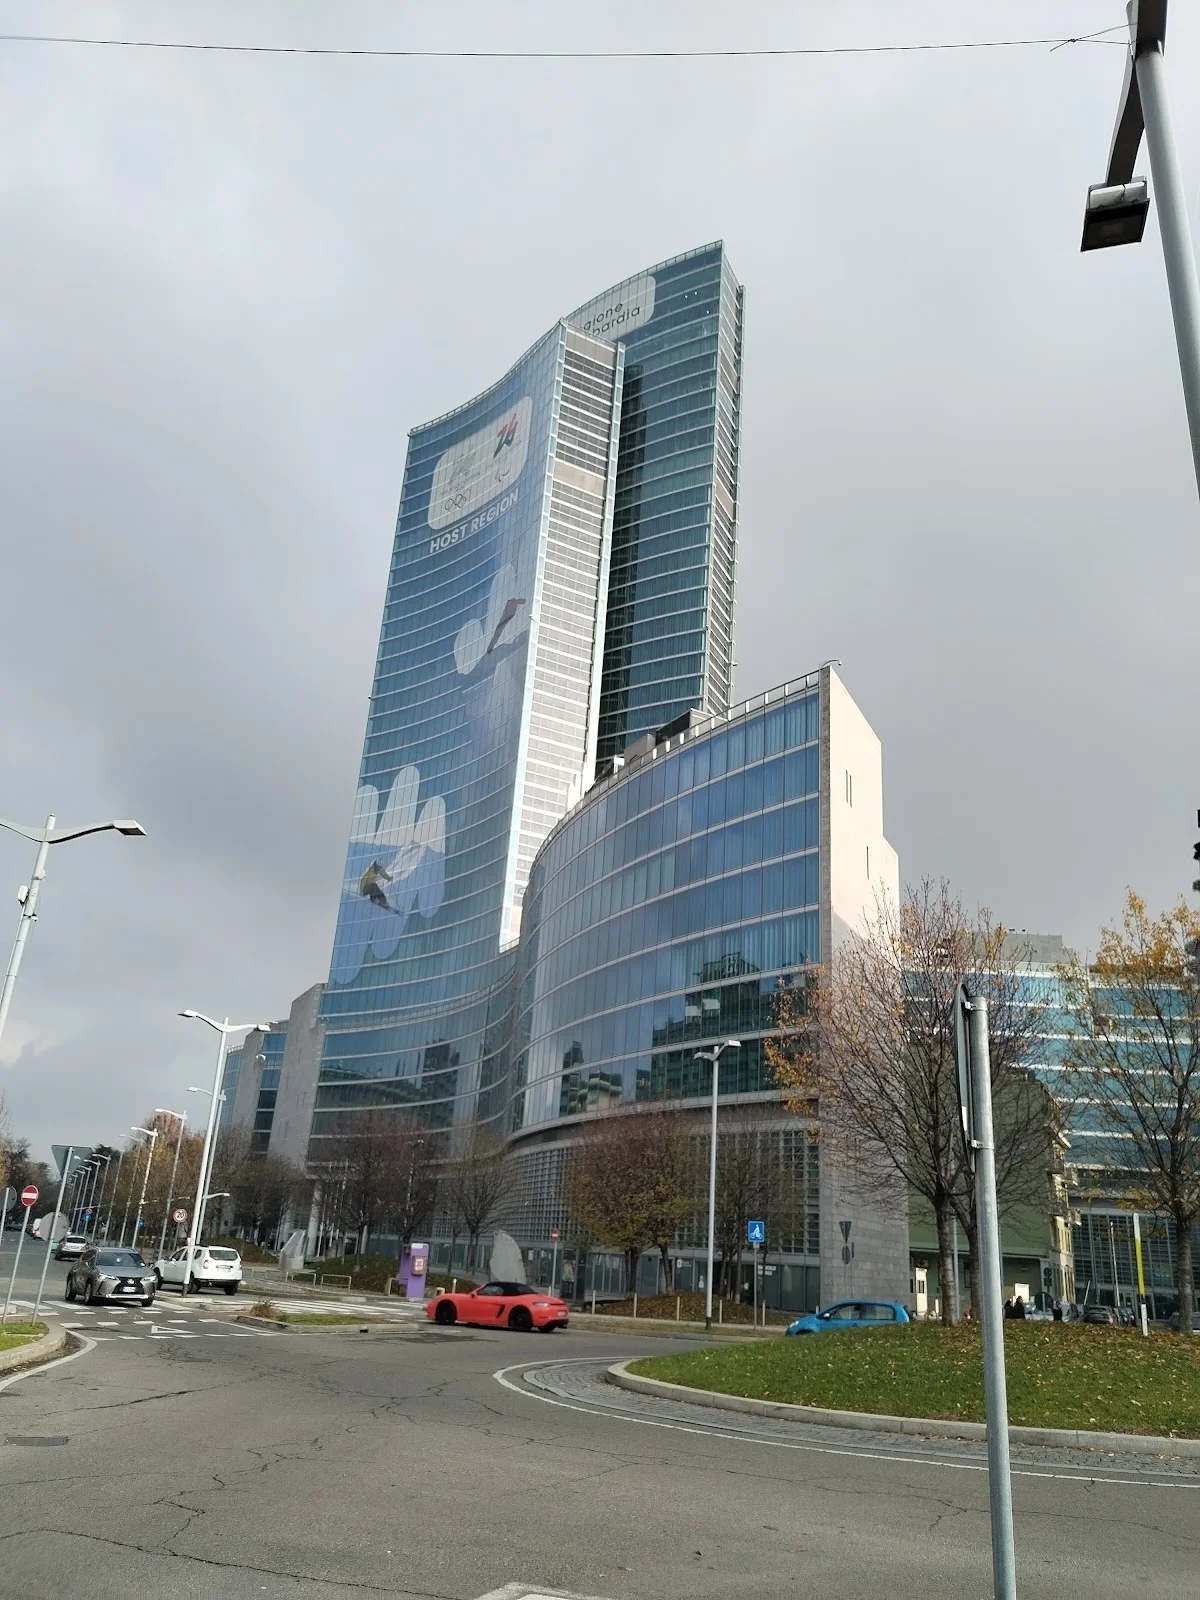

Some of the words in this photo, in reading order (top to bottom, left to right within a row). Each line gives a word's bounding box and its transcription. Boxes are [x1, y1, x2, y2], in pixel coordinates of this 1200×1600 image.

[592, 306, 640, 337] bardia
[429, 523, 469, 554] HOST
[471, 488, 519, 533] REGION
